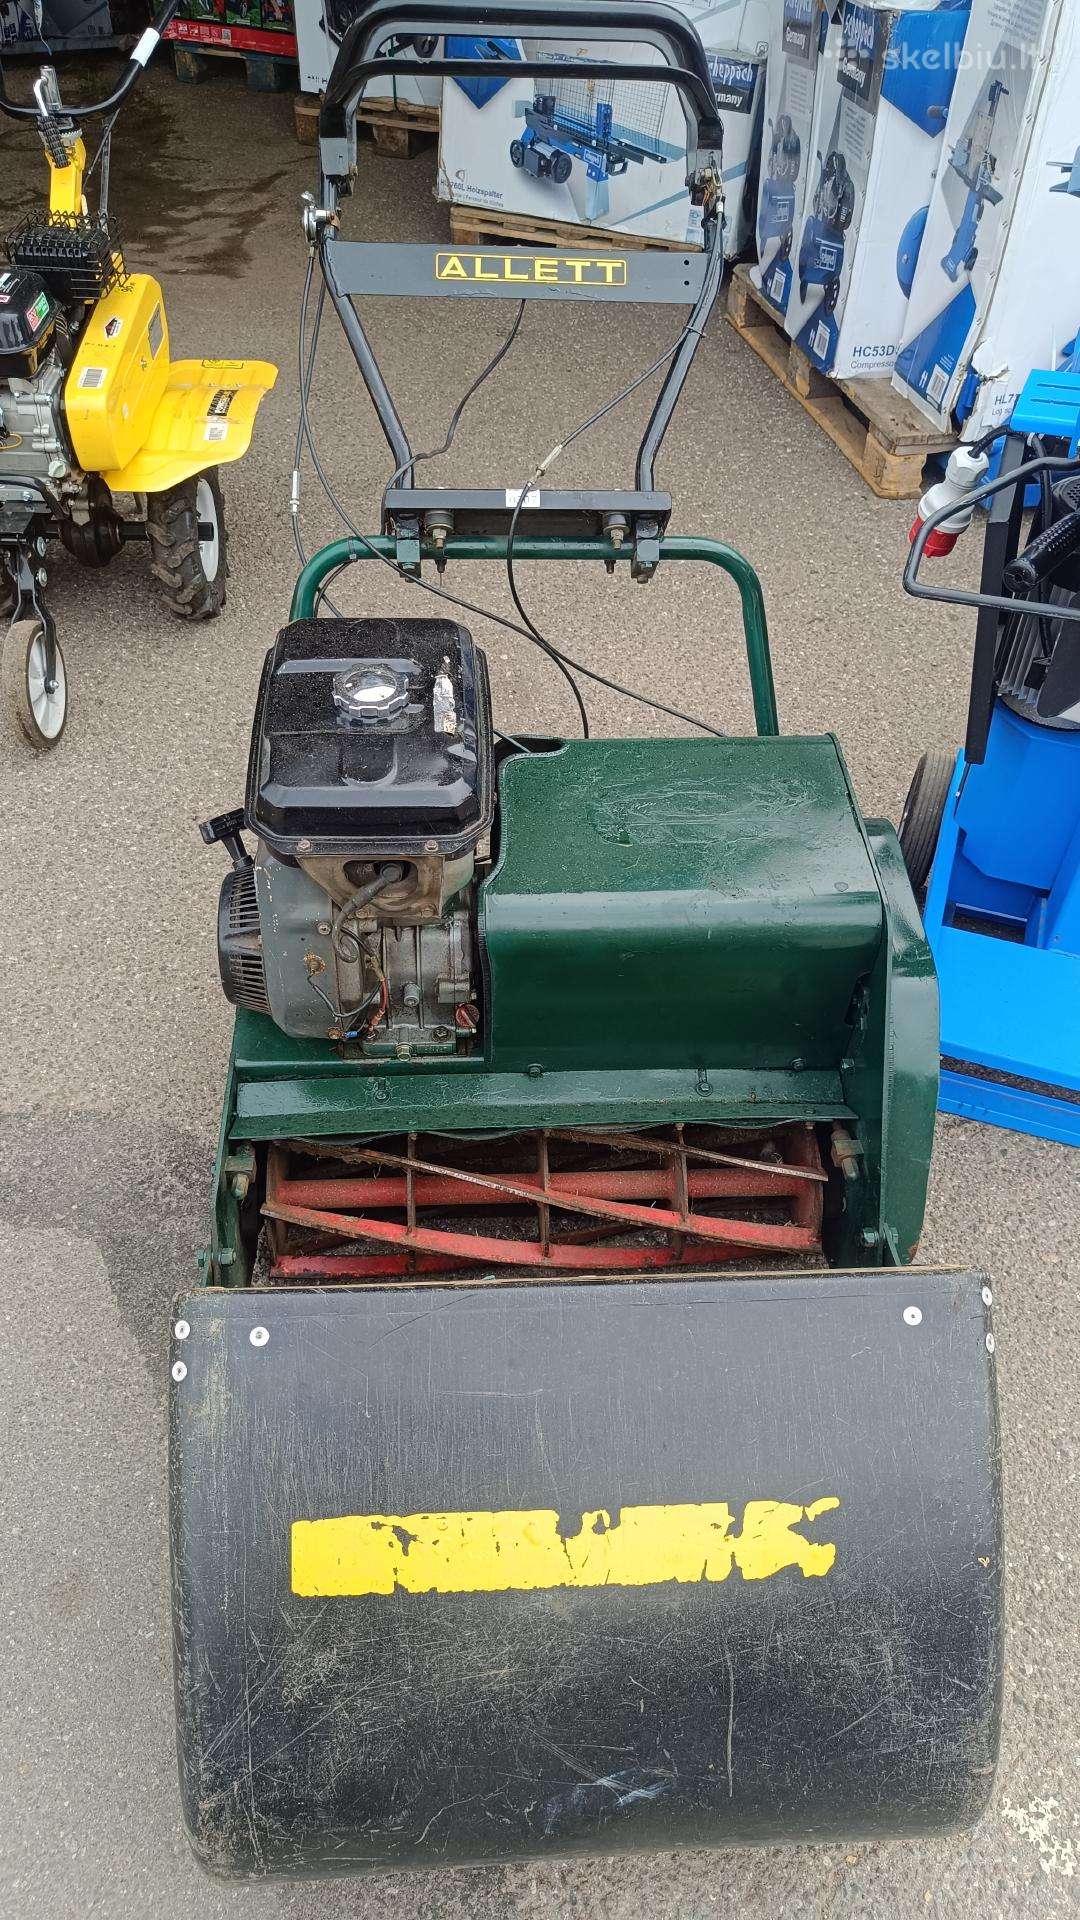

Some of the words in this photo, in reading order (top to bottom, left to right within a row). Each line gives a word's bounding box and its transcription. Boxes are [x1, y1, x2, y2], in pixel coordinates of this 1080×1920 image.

[707, 55, 753, 86] cheppach
[842, 56, 867, 89] Germany
[715, 93, 743, 107] rmany
[439, 256, 622, 283] ALLETT
